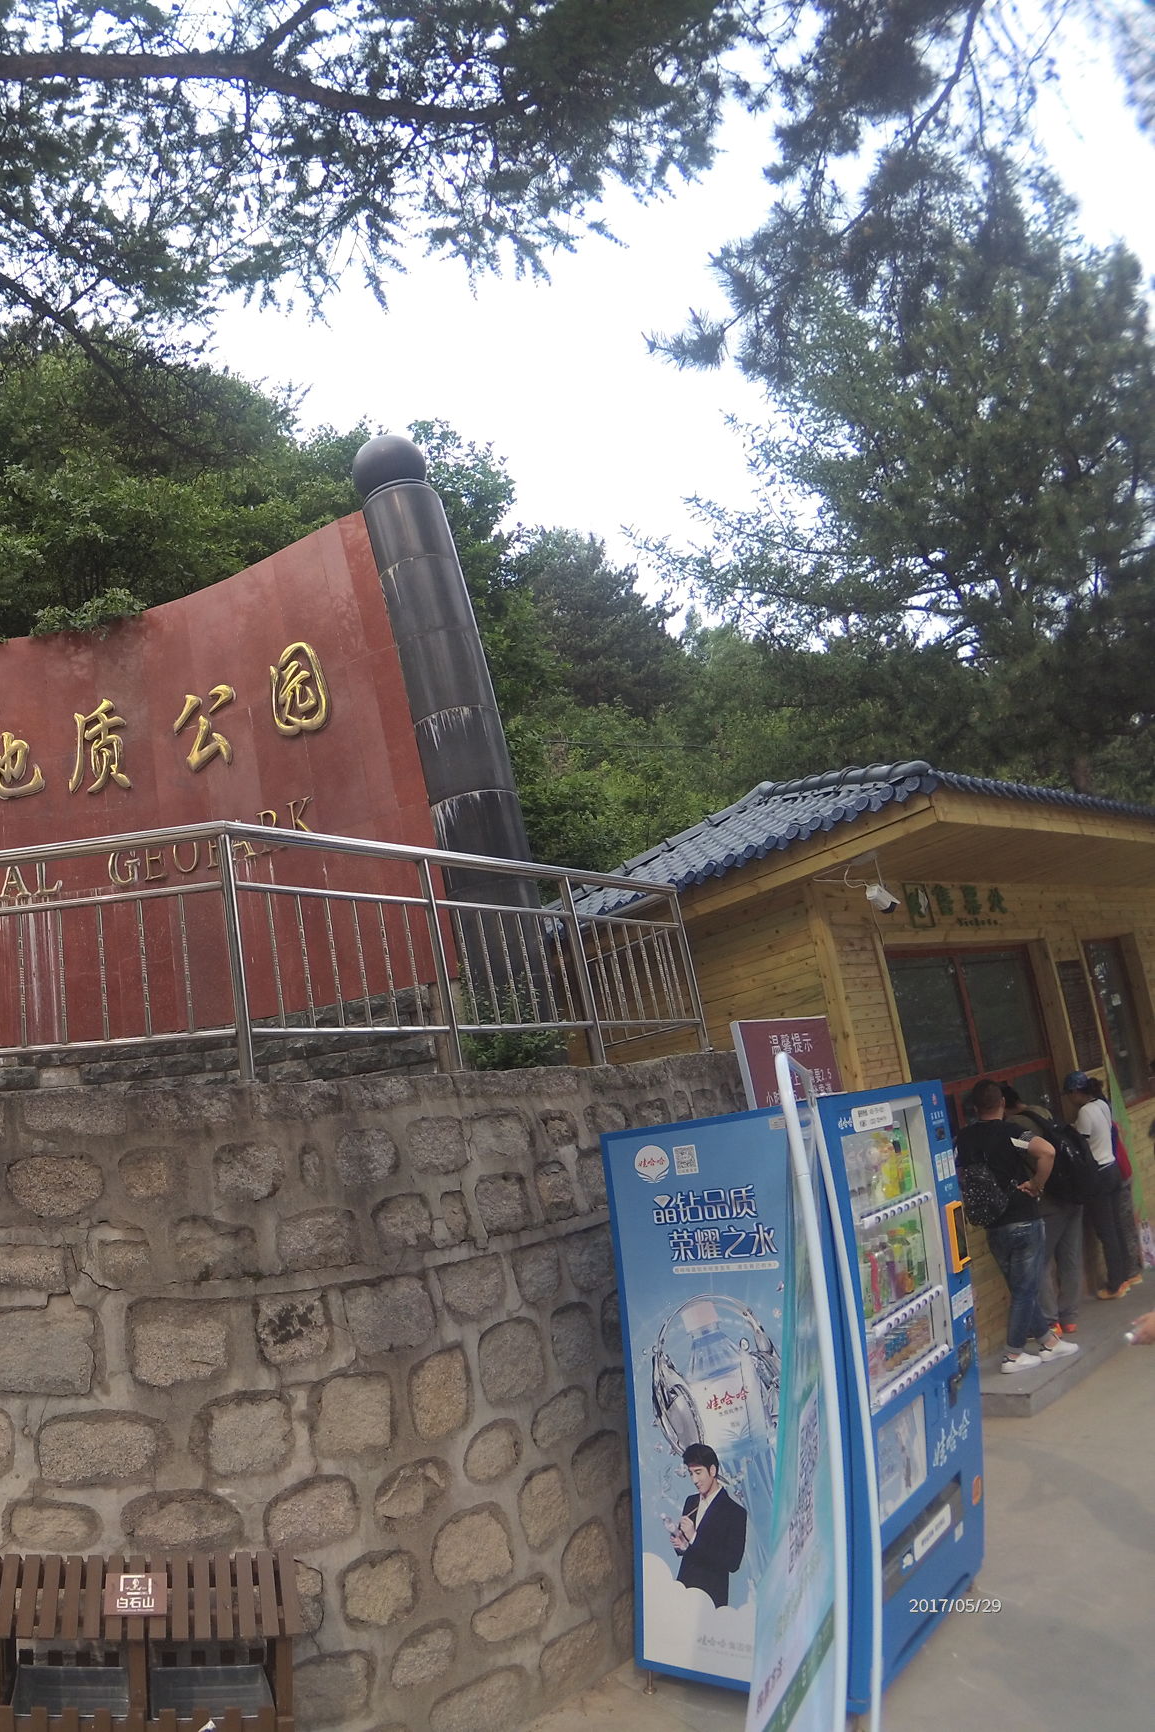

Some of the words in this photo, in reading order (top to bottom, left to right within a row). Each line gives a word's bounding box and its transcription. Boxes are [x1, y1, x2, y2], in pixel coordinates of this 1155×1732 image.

[637, 1156, 666, 1168] 娃哈哈
[668, 1222, 779, 1263] 荣耀之水
[706, 1385, 749, 1410] 娃哈哈
[116, 1596, 155, 1609] 白石山
